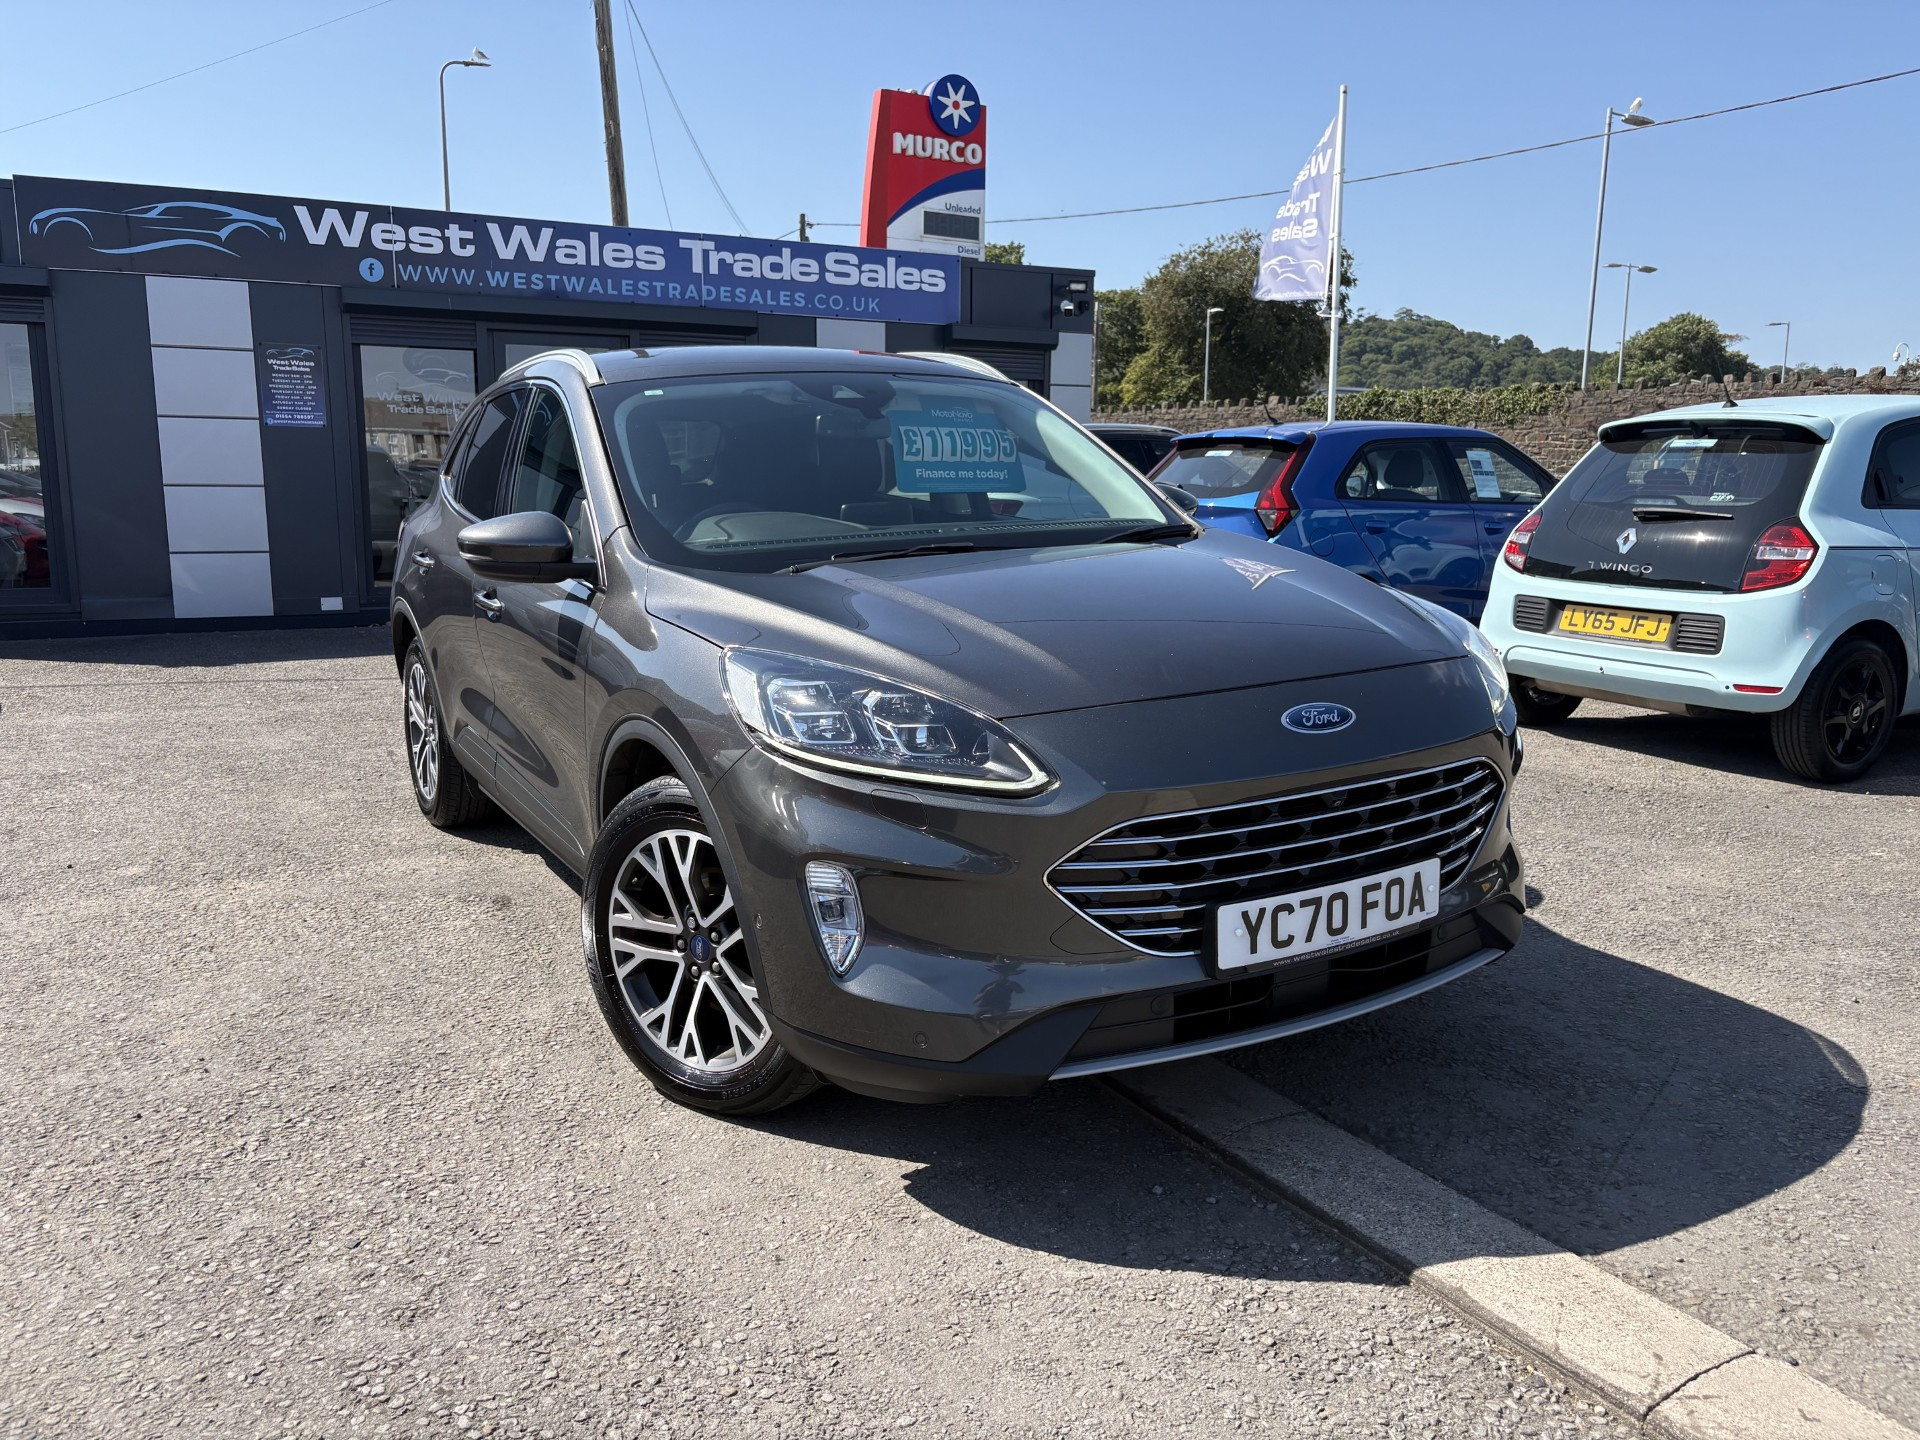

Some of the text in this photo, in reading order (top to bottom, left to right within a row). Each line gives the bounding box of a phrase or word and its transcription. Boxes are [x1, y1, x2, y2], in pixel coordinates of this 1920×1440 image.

[892, 131, 983, 165] MURCO
[944, 202, 982, 215] Unleaded
[293, 205, 947, 292] West Wales Trade Sales
[957, 245, 981, 256] Diesel
[398, 263, 880, 313] WWW.WESTWALESTRADESALES.CO.UK
[376, 391, 420, 403] West
[387, 404, 461, 415] Trade Sales
[903, 428, 1016, 458] £11995
[916, 469, 956, 478] Finance
[976, 469, 1008, 480] today!
[1567, 610, 1619, 633] LY65
[1620, 614, 1663, 637] JFJ
[1301, 707, 1341, 727] Ford
[1241, 871, 1426, 955] YC70 FOA
